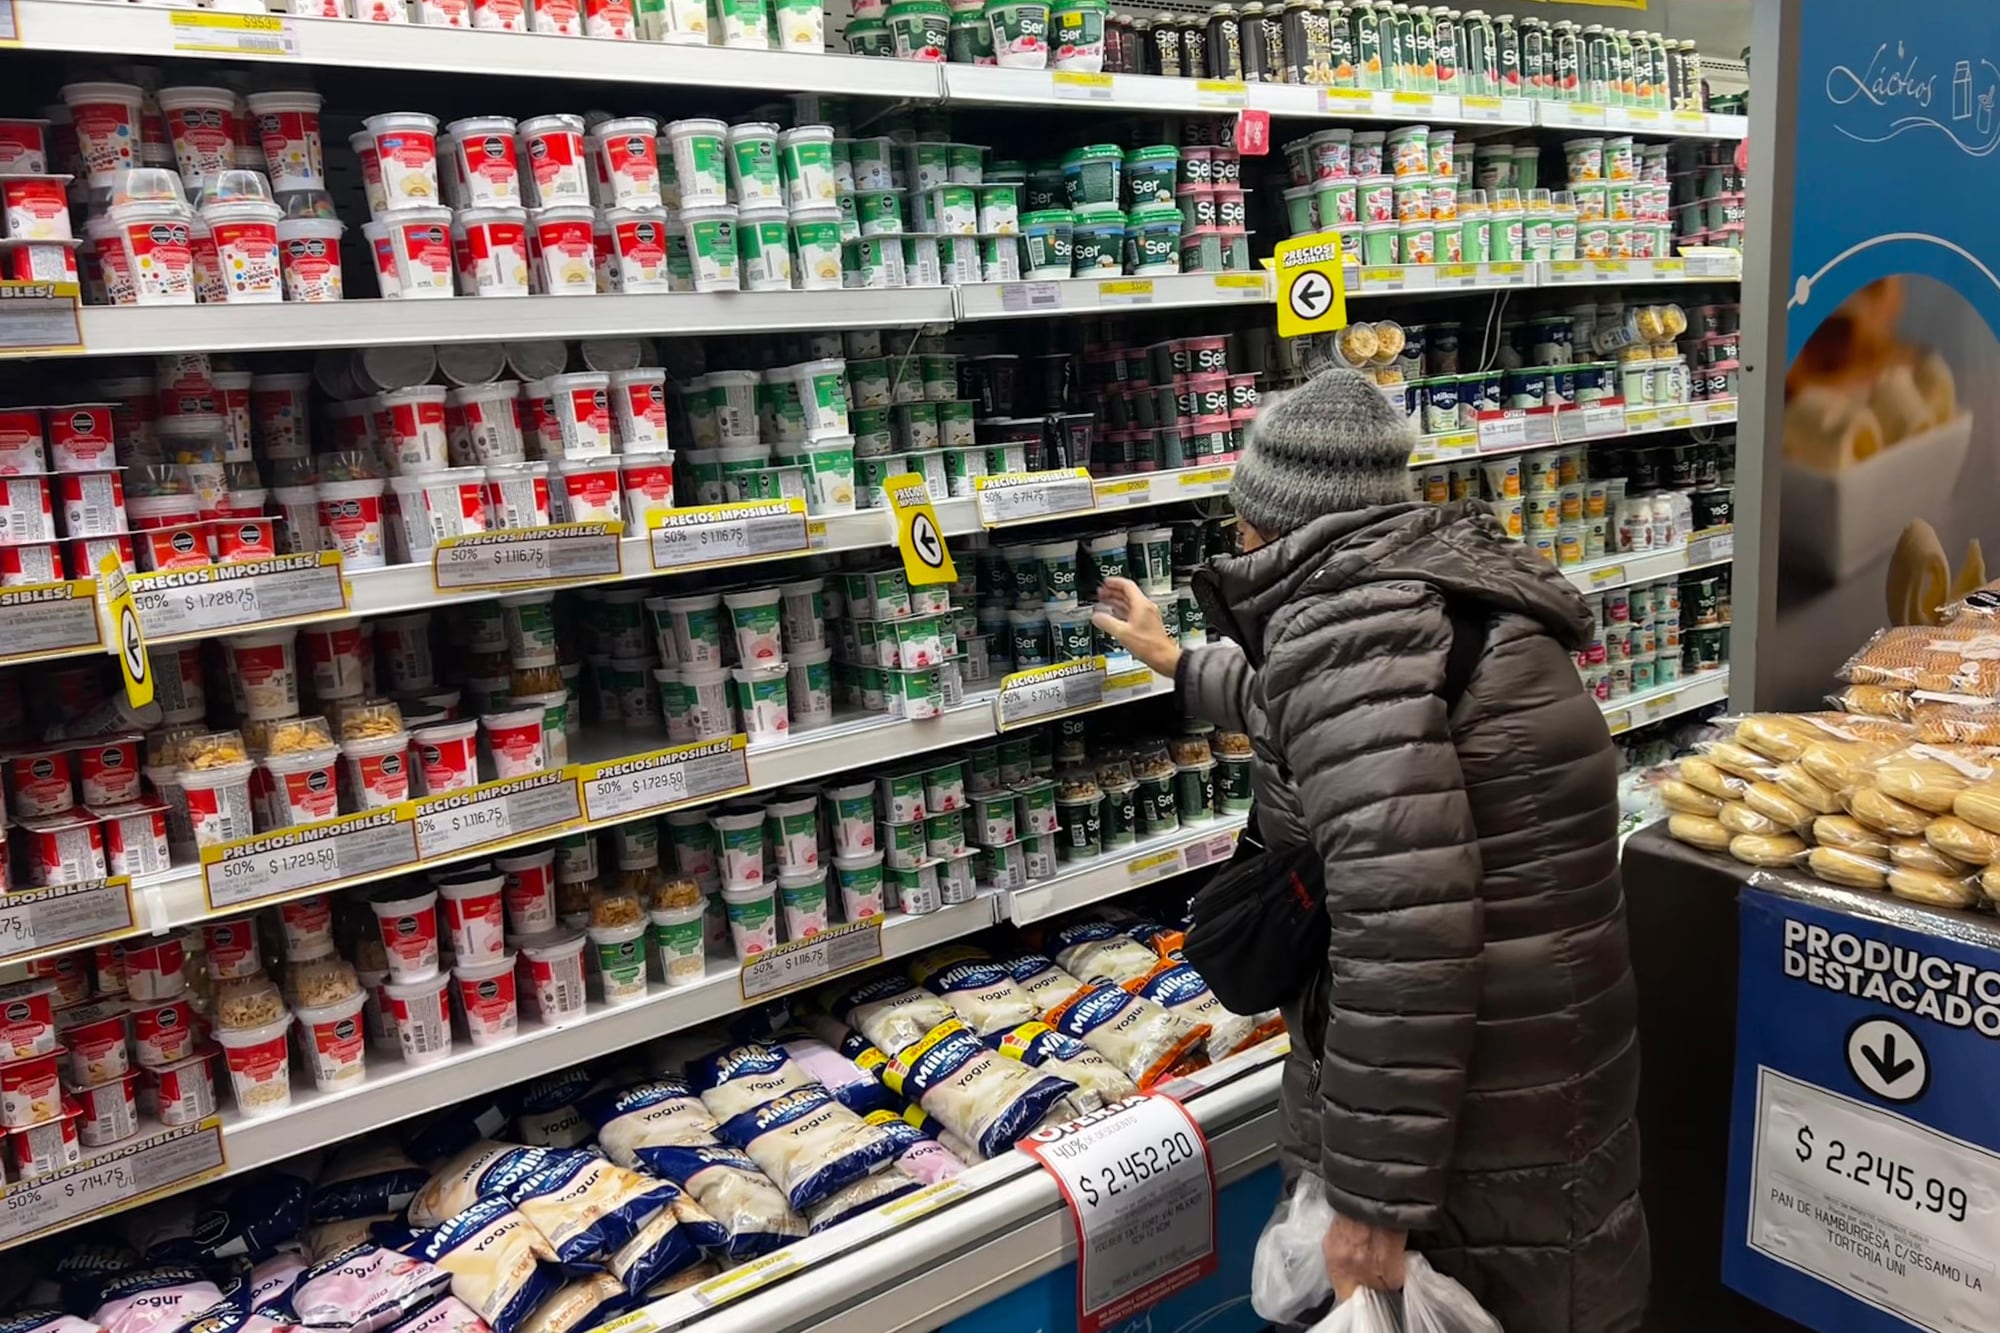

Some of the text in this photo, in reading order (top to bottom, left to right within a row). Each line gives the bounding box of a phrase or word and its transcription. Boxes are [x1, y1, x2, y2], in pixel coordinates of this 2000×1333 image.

[1021, 20, 1043, 34] Ser
[1059, 28, 1082, 42] Ser
[1222, 21, 1238, 34] Se
[926, 30, 946, 46] Ser
[1362, 30, 1379, 43] Se
[1417, 36, 1434, 49] Se
[1331, 39, 1351, 54] Se
[1826, 42, 1937, 107] Lácteos
[1132, 179, 1160, 195] Ser
[1197, 203, 1216, 219] Se
[1055, 241, 1071, 255] Se
[1075, 243, 1101, 259] Ser
[1145, 240, 1172, 254] Ser
[1206, 392, 1227, 408] Se
[1234, 387, 1255, 403] Se
[984, 492, 1001, 503] 50%
[662, 502, 791, 528] PRECIOS IMPOSIBLES!
[455, 524, 607, 548] PRECIOS IMPOSIBLES!
[663, 529, 687, 543] 50%
[701, 532, 708, 544] $
[451, 547, 478, 561] 50%
[494, 551, 502, 565] $
[132, 568, 209, 594] PRECIOS
[214, 551, 321, 581] IMPOSIBLES!
[1053, 571, 1075, 584] Ser
[1100, 563, 1123, 577] Ser
[135, 594, 168, 611] 50%
[185, 595, 195, 611] $
[1186, 611, 1203, 622] Ser
[1016, 636, 1037, 649] Ser
[1069, 636, 1090, 649] Ser
[1007, 661, 1097, 690] RECIOS IMPOSIBLES!
[1004, 690, 1020, 704] 50%
[596, 739, 733, 780] PRECIOS IMPOSIBLES!
[416, 769, 563, 817] RECIOS IMPOSIBLES!
[597, 780, 622, 796] 50%
[632, 779, 640, 794] $
[452, 817, 460, 831] $
[223, 808, 397, 862] PRECIOS IMPOSIBLES!
[224, 848, 335, 877] 50% $ 1.729,50
[804, 919, 873, 948] IMPOSIBLES!
[1101, 939, 1130, 952] Yogur
[753, 961, 774, 975] 50%
[785, 959, 792, 970] $
[1784, 918, 2000, 1005] PRODUCTO
[1027, 974, 1059, 993] Yogur
[888, 993, 923, 1009] Yogur
[978, 988, 1012, 1003] Yogur
[1784, 948, 2000, 1038] DESTACADO
[1070, 985, 1127, 1034] Milkau
[1196, 996, 1220, 1013] Yog
[1114, 1005, 1145, 1032] Yogur
[717, 1051, 782, 1086] Milkaut
[1079, 1056, 1103, 1066] Yog
[957, 1058, 993, 1088] Yogur
[747, 1077, 786, 1091] Yogur
[643, 1103, 687, 1122] Yogur
[791, 1111, 833, 1136] Yogur
[1054, 1138, 1088, 1160] 40%
[1079, 1132, 1193, 1208] $ 2.452,20
[1796, 1125, 1814, 1163] $
[1826, 1140, 1968, 1222] 2.245,99
[8, 1167, 124, 1210] 50% $ 714,75
[426, 1196, 508, 1258] Milkau
[474, 1220, 521, 1252] Yogur
[1771, 1188, 1794, 1208] PAN
[1797, 1199, 1811, 1217] DE
[1815, 1208, 1891, 1251] HAMBURGESA
[1895, 1244, 1961, 1283] C/SESAMO
[1965, 1273, 1983, 1292] LA
[1827, 1229, 1907, 1278] TORTERIA UNI
